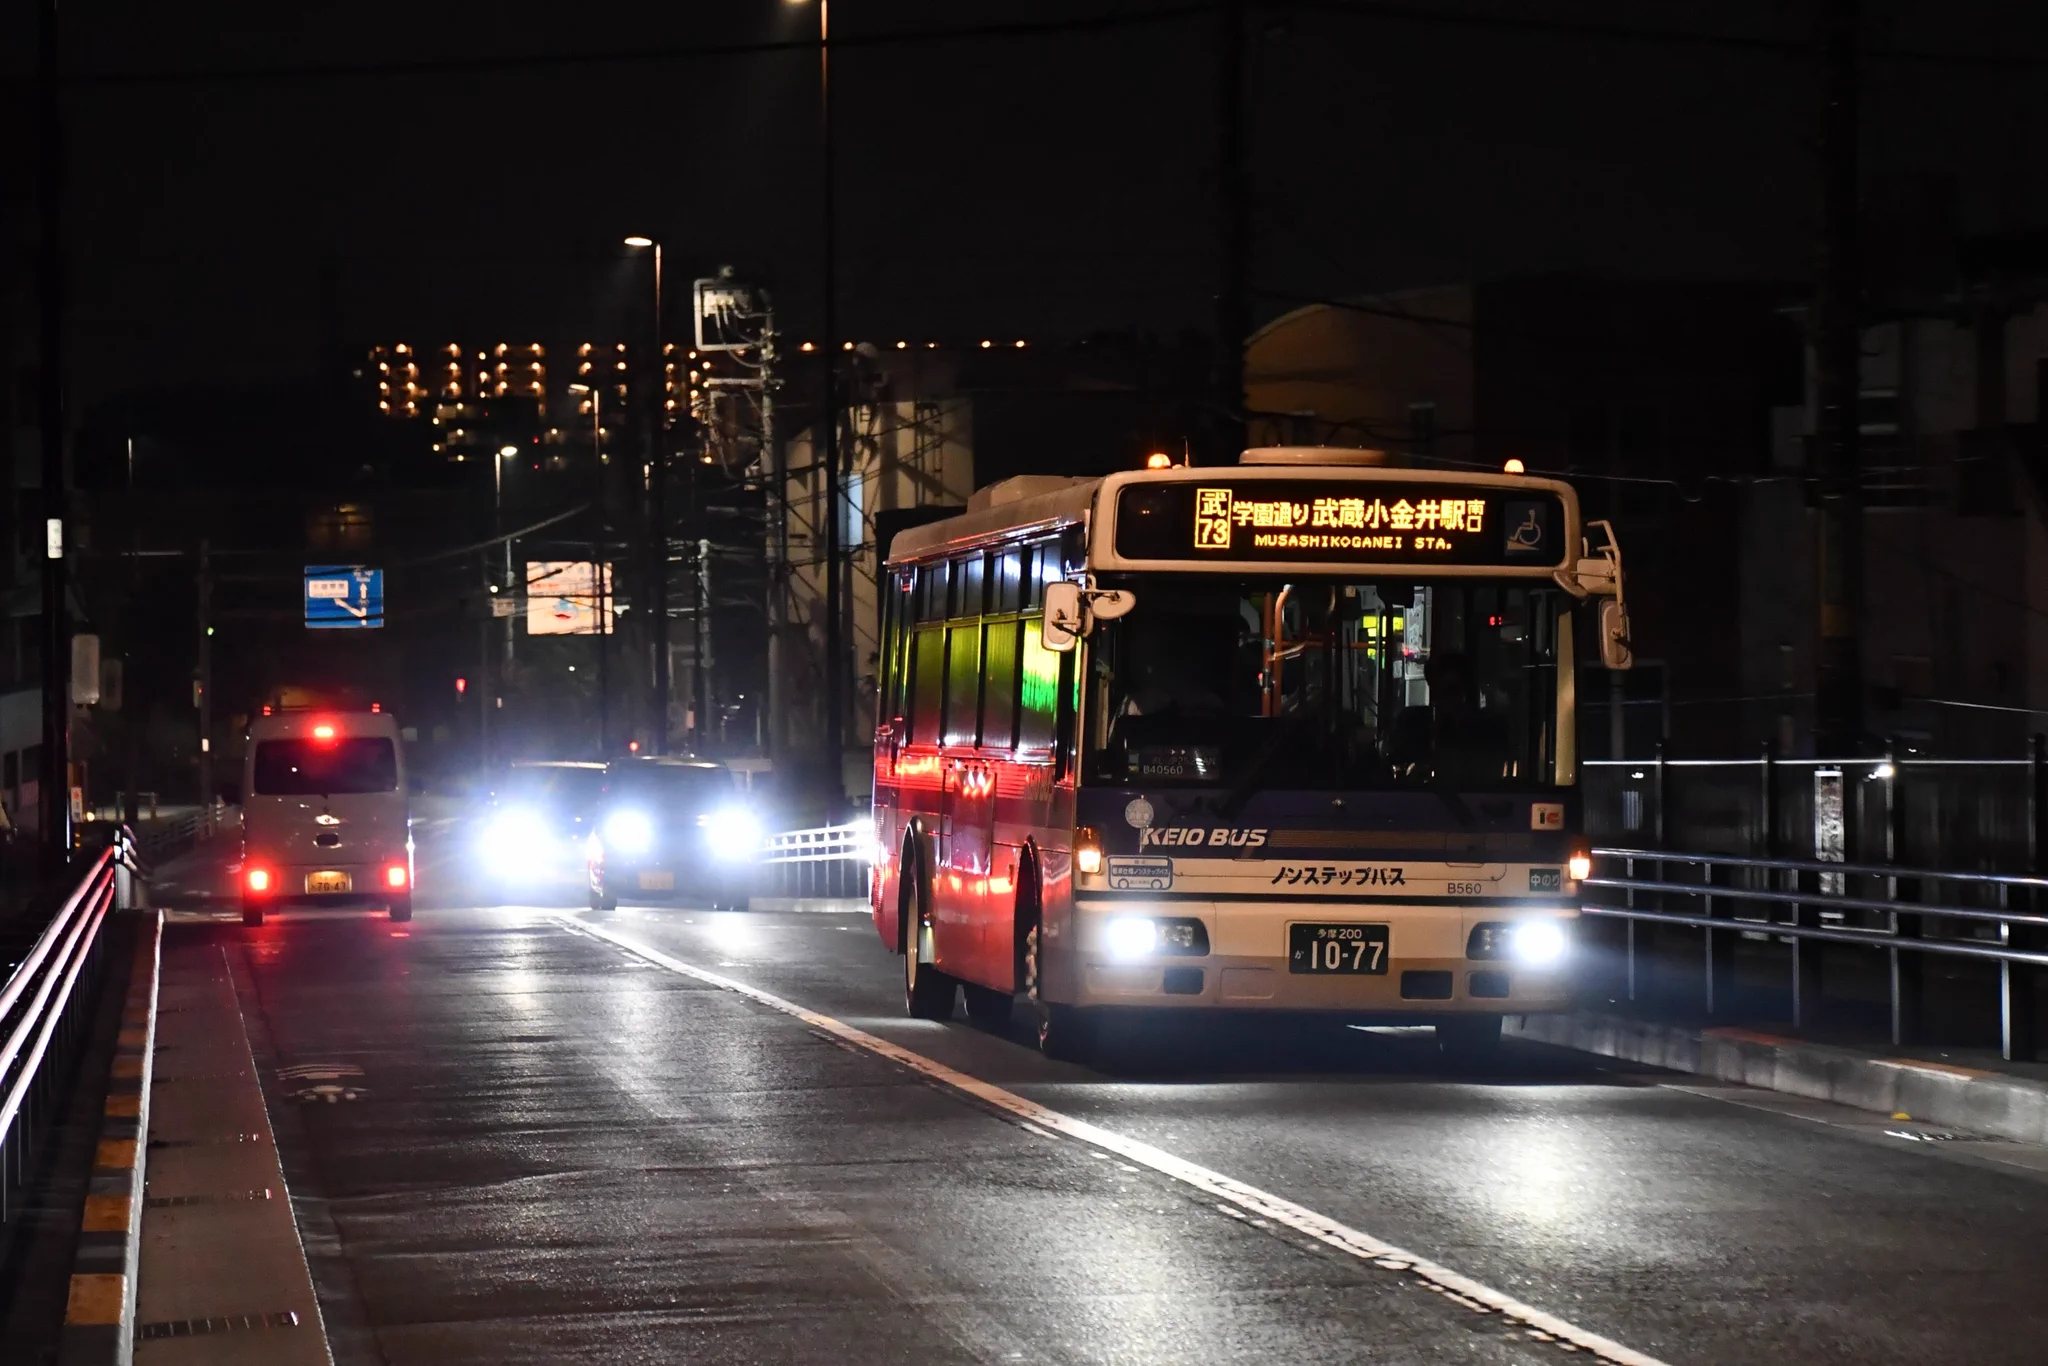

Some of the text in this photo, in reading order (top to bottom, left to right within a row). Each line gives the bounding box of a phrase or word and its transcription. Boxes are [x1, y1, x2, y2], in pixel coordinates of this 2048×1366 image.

[1201, 492, 1228, 517] 武
[1199, 518, 1229, 544] 73
[1254, 533, 1452, 550] MUSASHIKOGANEI STA.
[1143, 765, 1183, 775] B40560
[1142, 827, 1268, 848] KEIO BUS
[1271, 866, 1406, 886] ノンステップバス
[1531, 873, 1560, 887] 中のり
[1447, 882, 1482, 895] B560
[1311, 940, 1384, 970] 10-77
